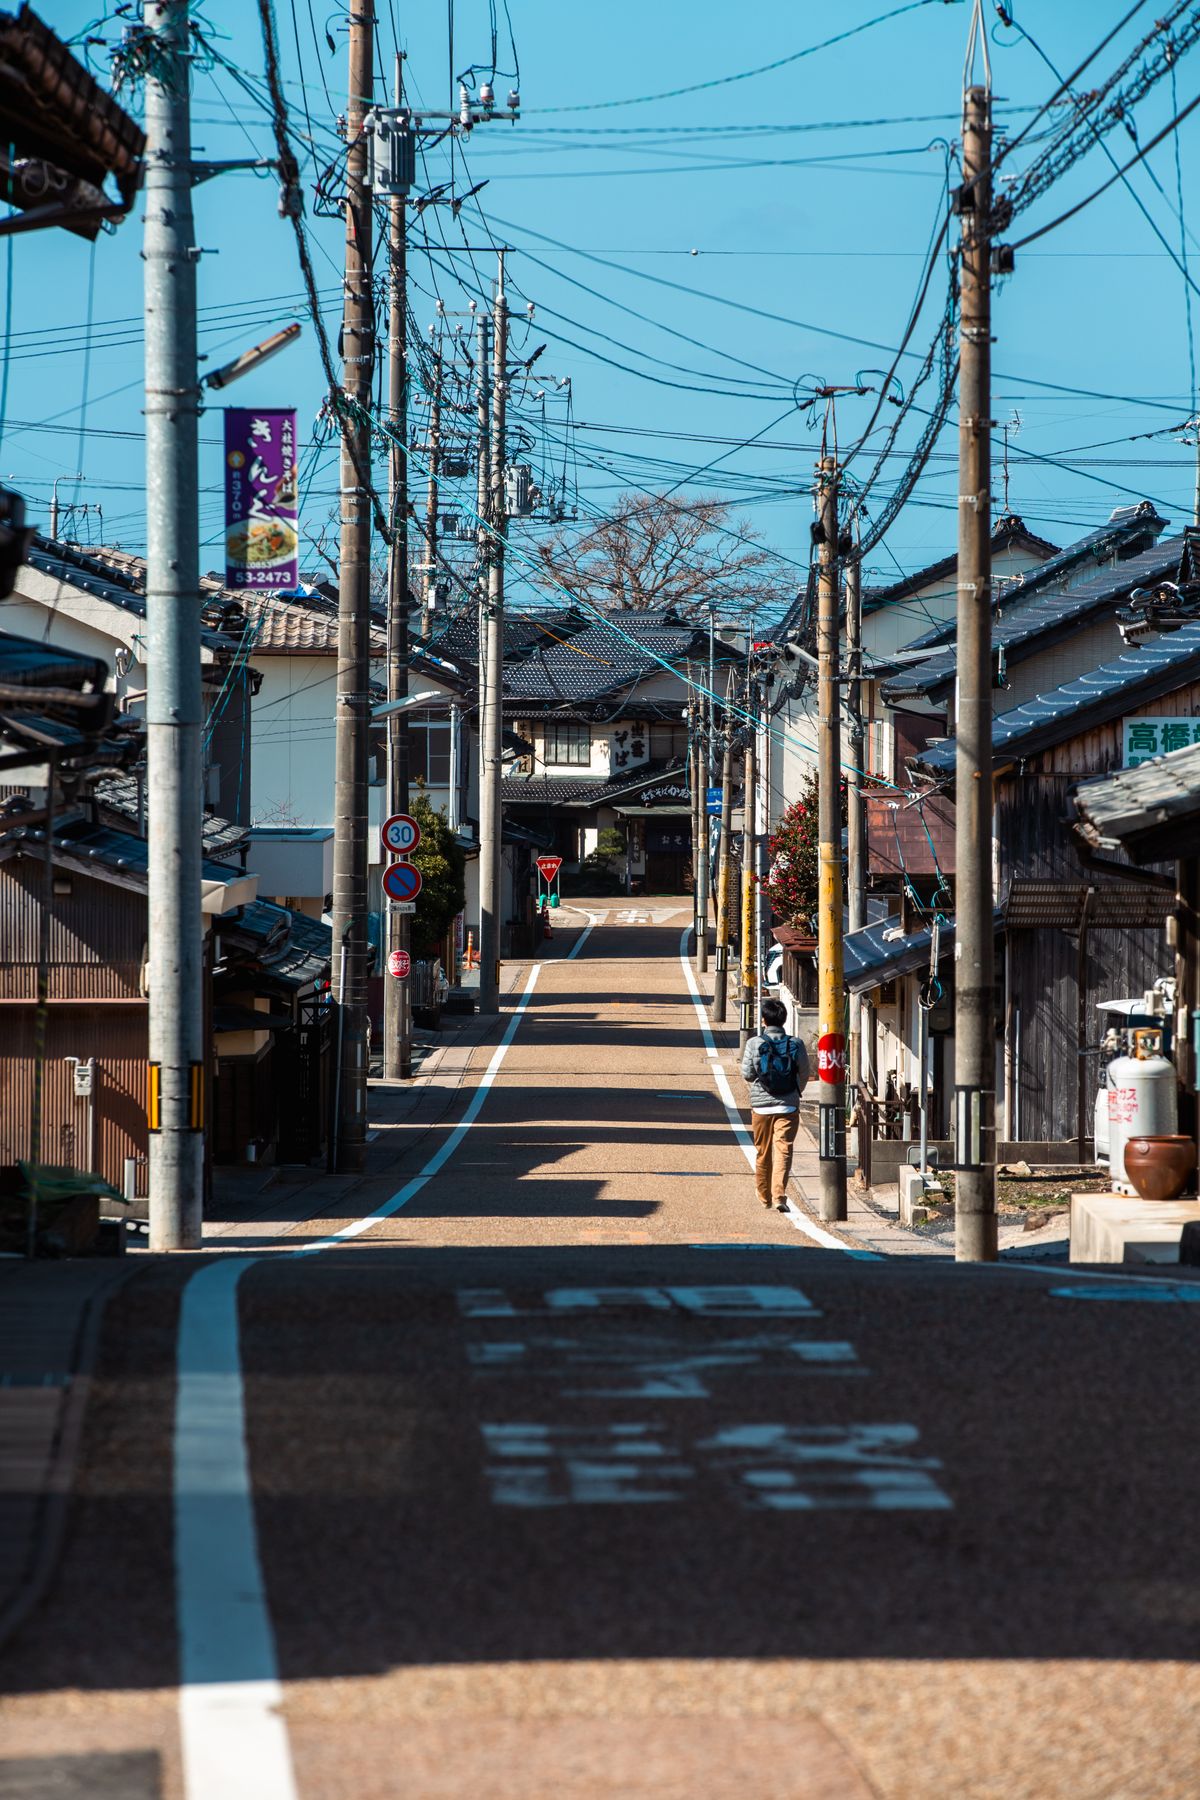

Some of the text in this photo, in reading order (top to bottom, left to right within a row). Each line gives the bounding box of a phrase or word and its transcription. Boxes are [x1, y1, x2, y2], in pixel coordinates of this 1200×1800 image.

[235, 572, 291, 583] 53-2473
[614, 730, 630, 767] そば
[631, 721, 645, 758] 出雲
[390, 826, 412, 843] 30
